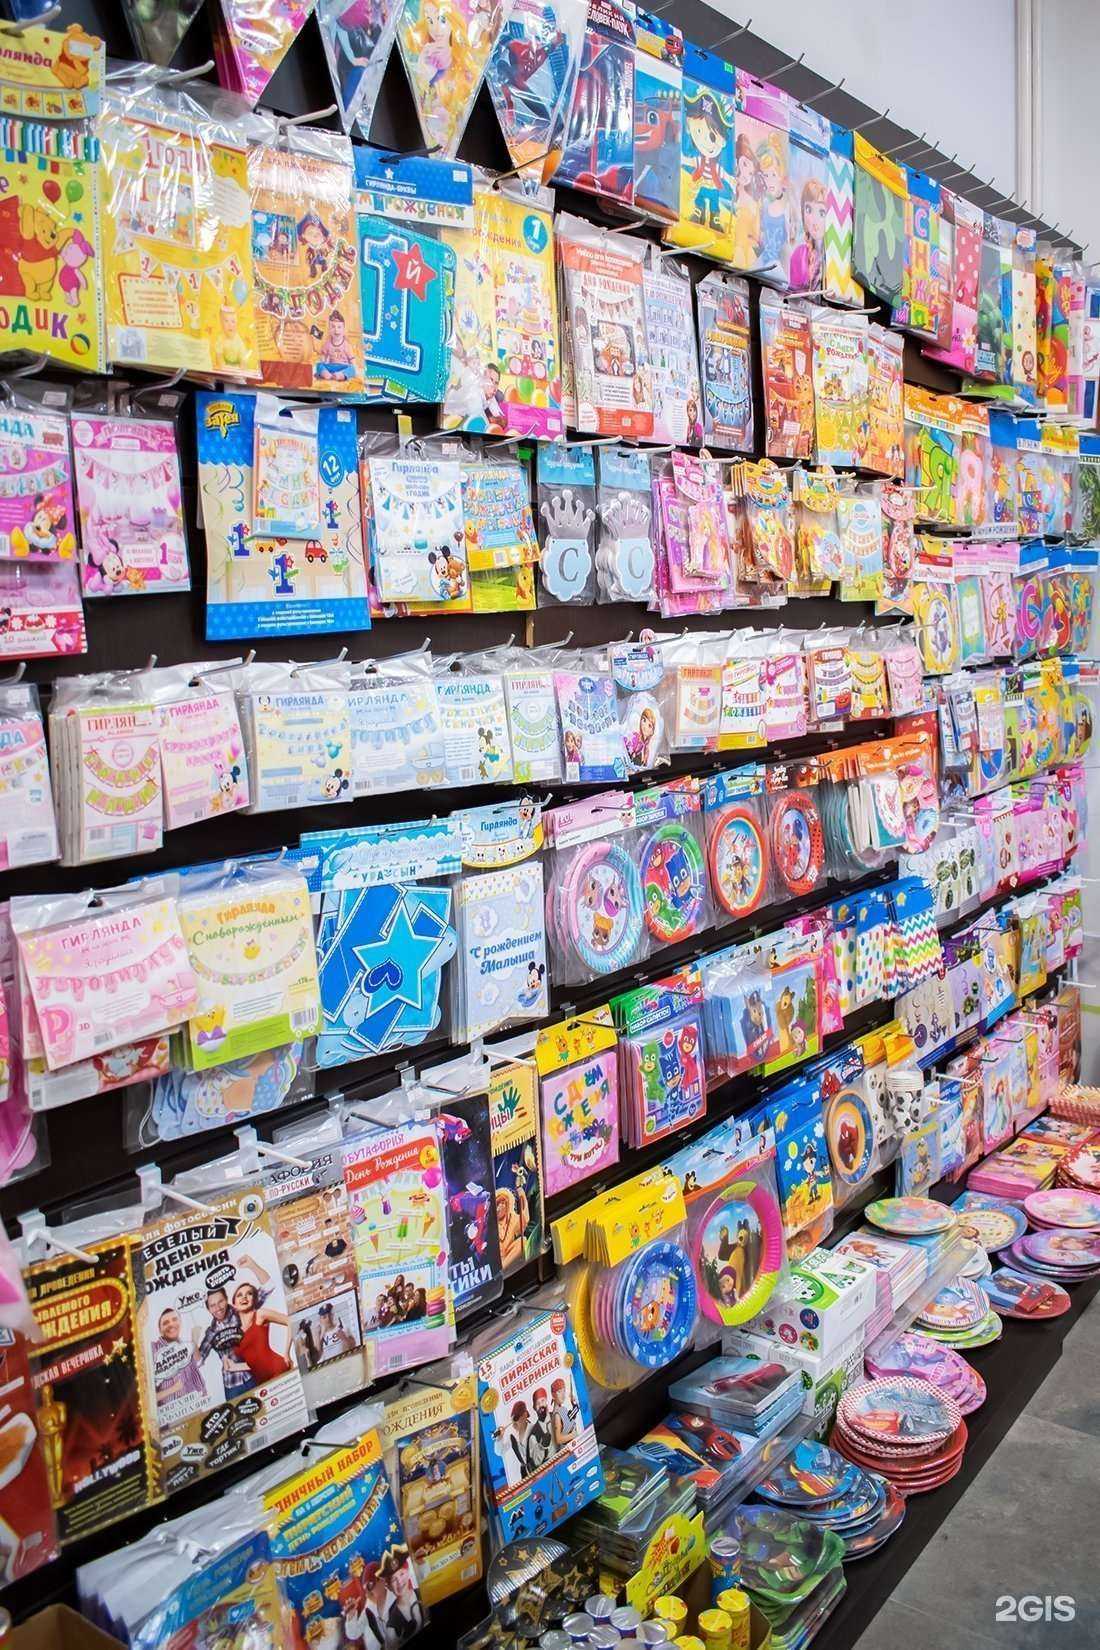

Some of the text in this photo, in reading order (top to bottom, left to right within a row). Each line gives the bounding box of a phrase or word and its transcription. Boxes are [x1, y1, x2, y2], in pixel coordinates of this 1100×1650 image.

[322, 455, 341, 477] 12
[168, 698, 220, 718] ГИРЛЯНДА
[275, 695, 325, 706] ГИРЛЯНДА
[346, 692, 409, 707] ИРЛЯНДА
[480, 818, 519, 832] Гирлянда
[61, 917, 142, 950] ГИРЛЯНДА
[483, 930, 543, 958] рождением
[479, 949, 536, 975] Малыша
[345, 1147, 420, 1185] День Рождения
[269, 1176, 311, 1198] ПО-РУССКИ
[142, 1223, 217, 1260] ЕСЕЛЫЙ
[155, 1243, 203, 1275] ДЕНЬ
[40, 1267, 96, 1298] ПРОВЕДЕНИЯ
[178, 1291, 200, 1305] Уже
[60, 1344, 104, 1376] ВЕЧЕРИНКА
[155, 1348, 189, 1369] ДАРИЛИ
[480, 1360, 493, 1377] 15
[500, 1341, 559, 1388] ПИРАТСКАЯ
[503, 1358, 560, 1402] ВЕЧЕРИНКА
[204, 1411, 221, 1430] КТО
[384, 1401, 446, 1436] ОЖДЕНИЯ
[336, 1440, 374, 1473] НАБОР
[73, 1449, 141, 1494] HOLLYWOOD
